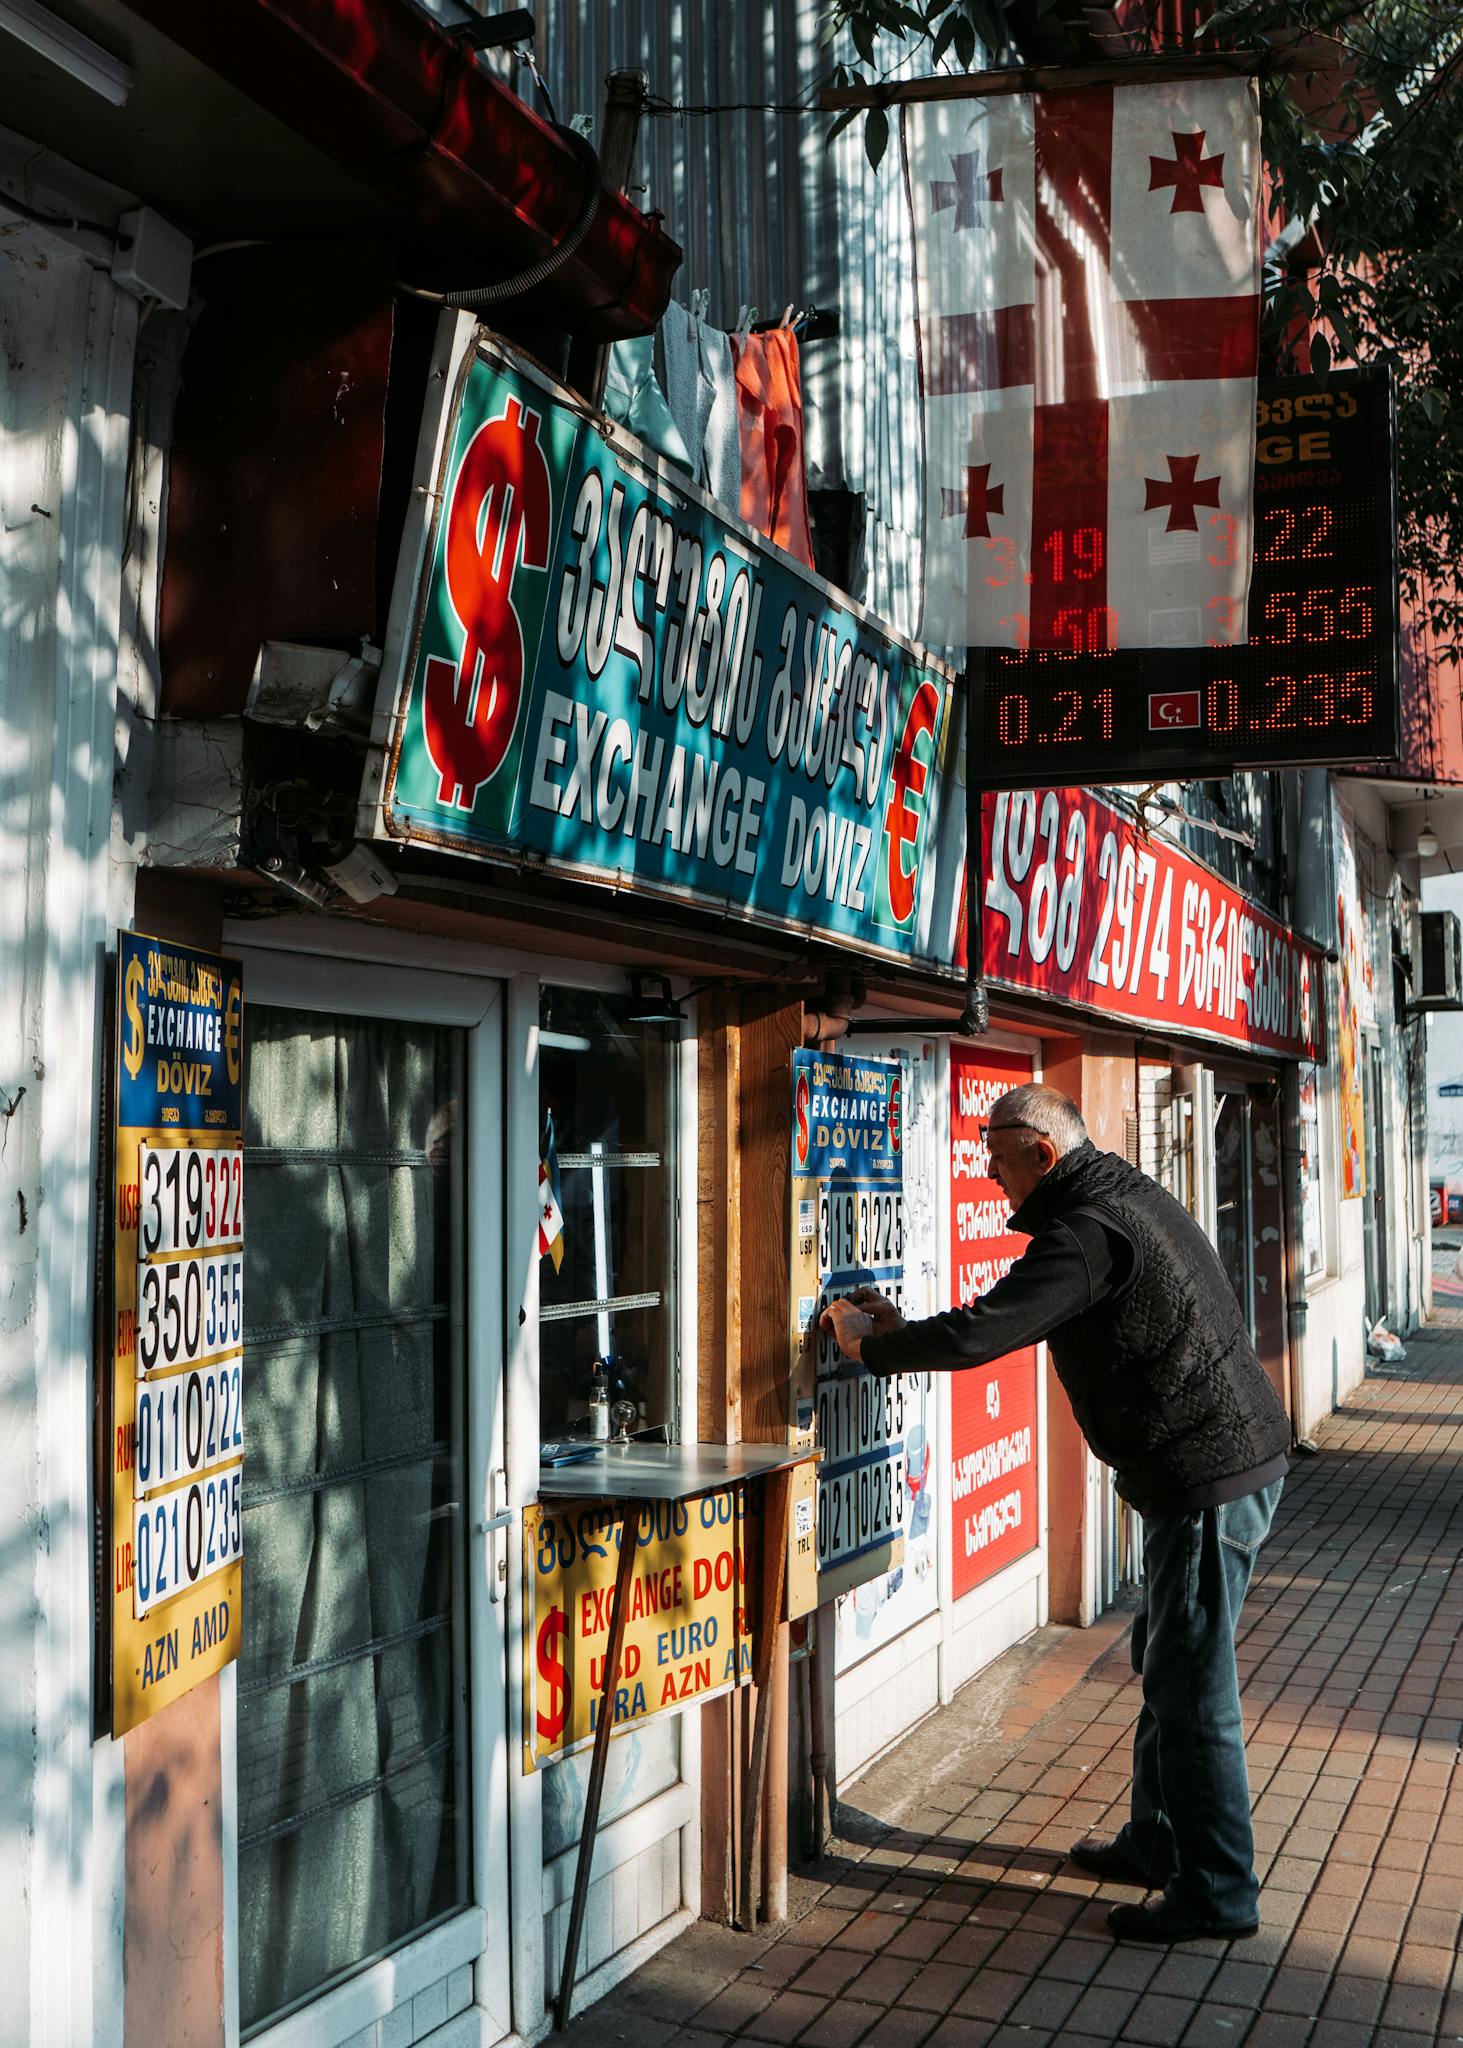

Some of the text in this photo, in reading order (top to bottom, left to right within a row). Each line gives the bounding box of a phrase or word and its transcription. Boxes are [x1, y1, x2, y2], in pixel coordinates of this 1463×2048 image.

[556, 467, 890, 808] ვალუტის გაცვლა
[999, 687, 1113, 745] 0.21
[1207, 670, 1374, 732] 0.235
[529, 690, 873, 912] EXCHANGE DOVIZ
[1087, 831, 1174, 1002] 2974
[1178, 879, 1289, 1038] წვრილმანი
[147, 1003, 222, 1053] EXCHANGE
[156, 1051, 212, 1097] DÖVIZ
[811, 1094, 887, 1122] EXCHANGE
[816, 1121, 884, 1151] DÖVIZ
[799, 1238, 813, 1256] USD
[801, 1223, 812, 1234] USD
[797, 1537, 811, 1555] TRL
[142, 1599, 231, 1691] AZN AMD
[657, 1615, 718, 1667] EURO
[660, 1657, 711, 1706] AZN
